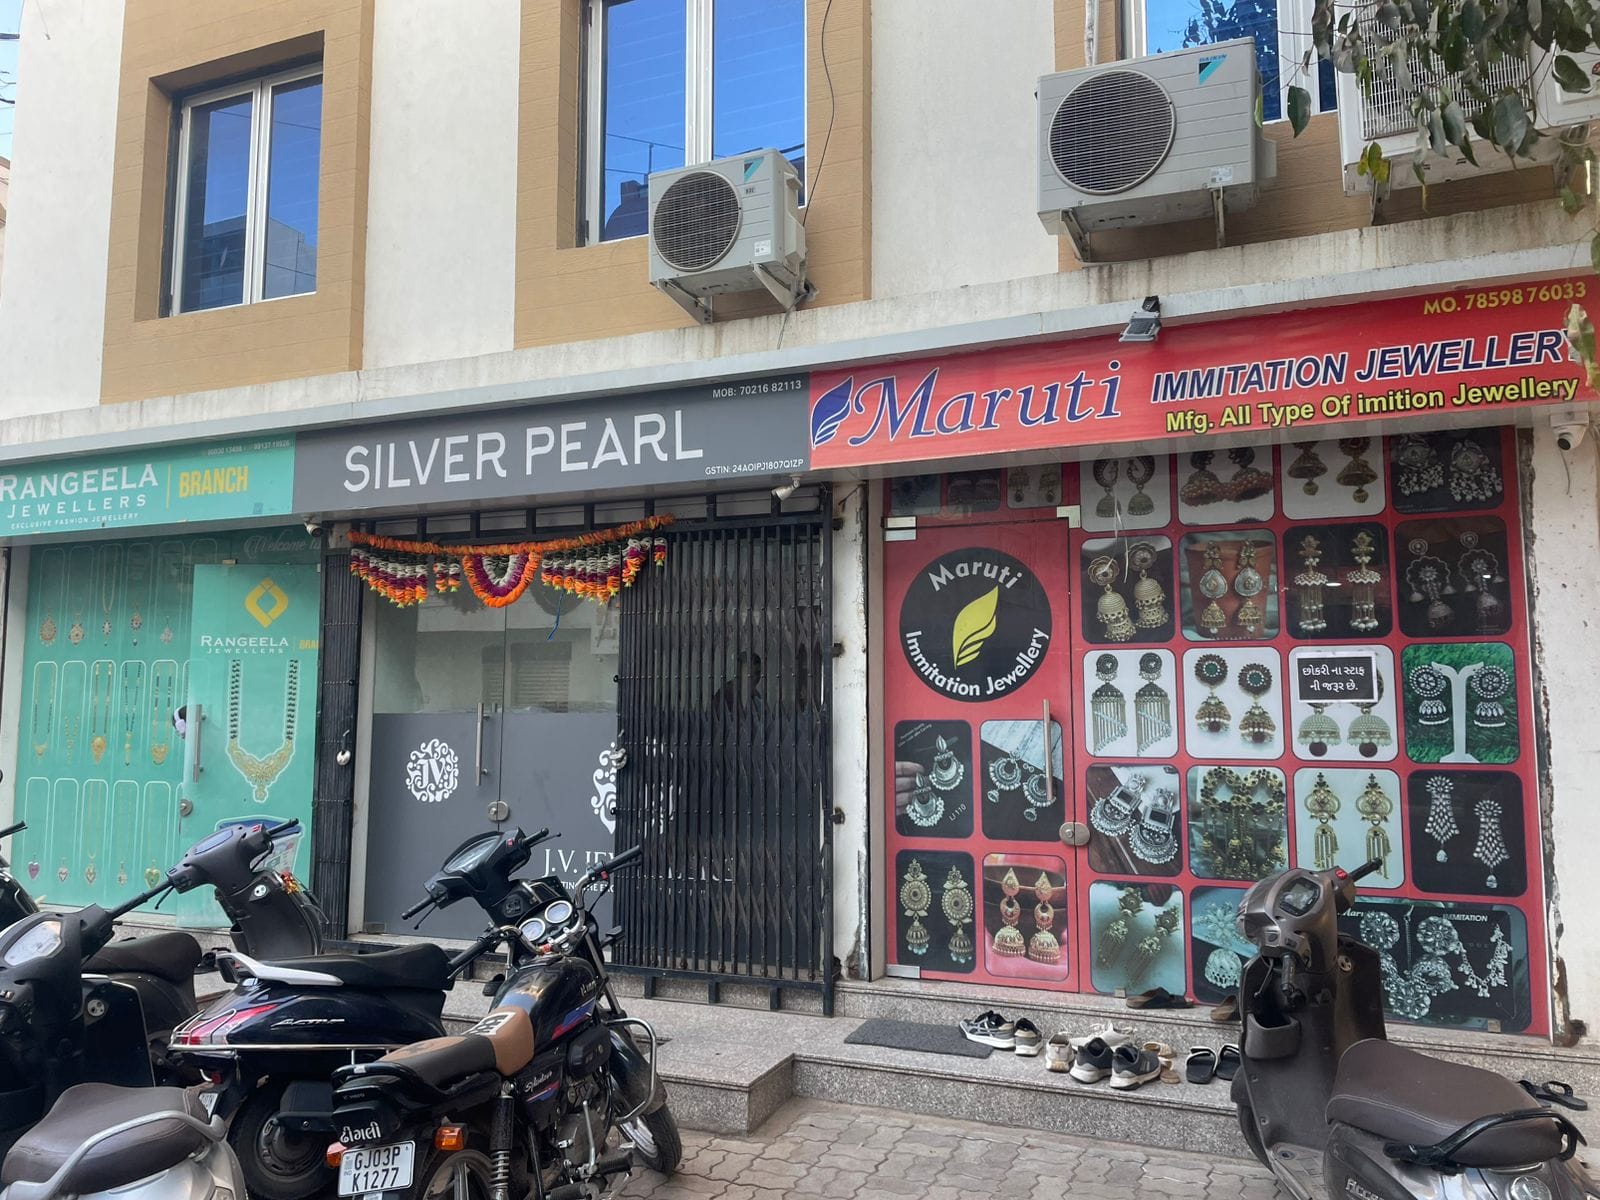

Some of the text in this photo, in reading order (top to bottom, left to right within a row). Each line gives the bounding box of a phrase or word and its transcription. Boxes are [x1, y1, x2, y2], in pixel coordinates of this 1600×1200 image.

[1423, 282, 1587, 315] MO. 78598 76033
[712, 380, 802, 399] MOB: 70216 82113
[1151, 352, 1348, 404] IMMITATION
[848, 359, 1121, 447] Maruti
[1166, 375, 1579, 434] Mfg. All Type Of imition Jewellery
[343, 409, 704, 493] SILVER PEARL
[0, 463, 158, 501] RANGEELA
[178, 465, 249, 498] BRANCH
[7, 494, 147, 519] JEWELLERS
[11, 513, 138, 530] EXCLUSIVE FASHION JEWELLERY
[928, 561, 1023, 592] Maruti
[906, 627, 1049, 696] Immitation Jewellery
[1302, 664, 1330, 676] છોકરી
[1331, 666, 1342, 675] ના
[1310, 679, 1320, 691] ની
[354, 1146, 401, 1170] GJ03P
[352, 1167, 400, 1192] K1277
